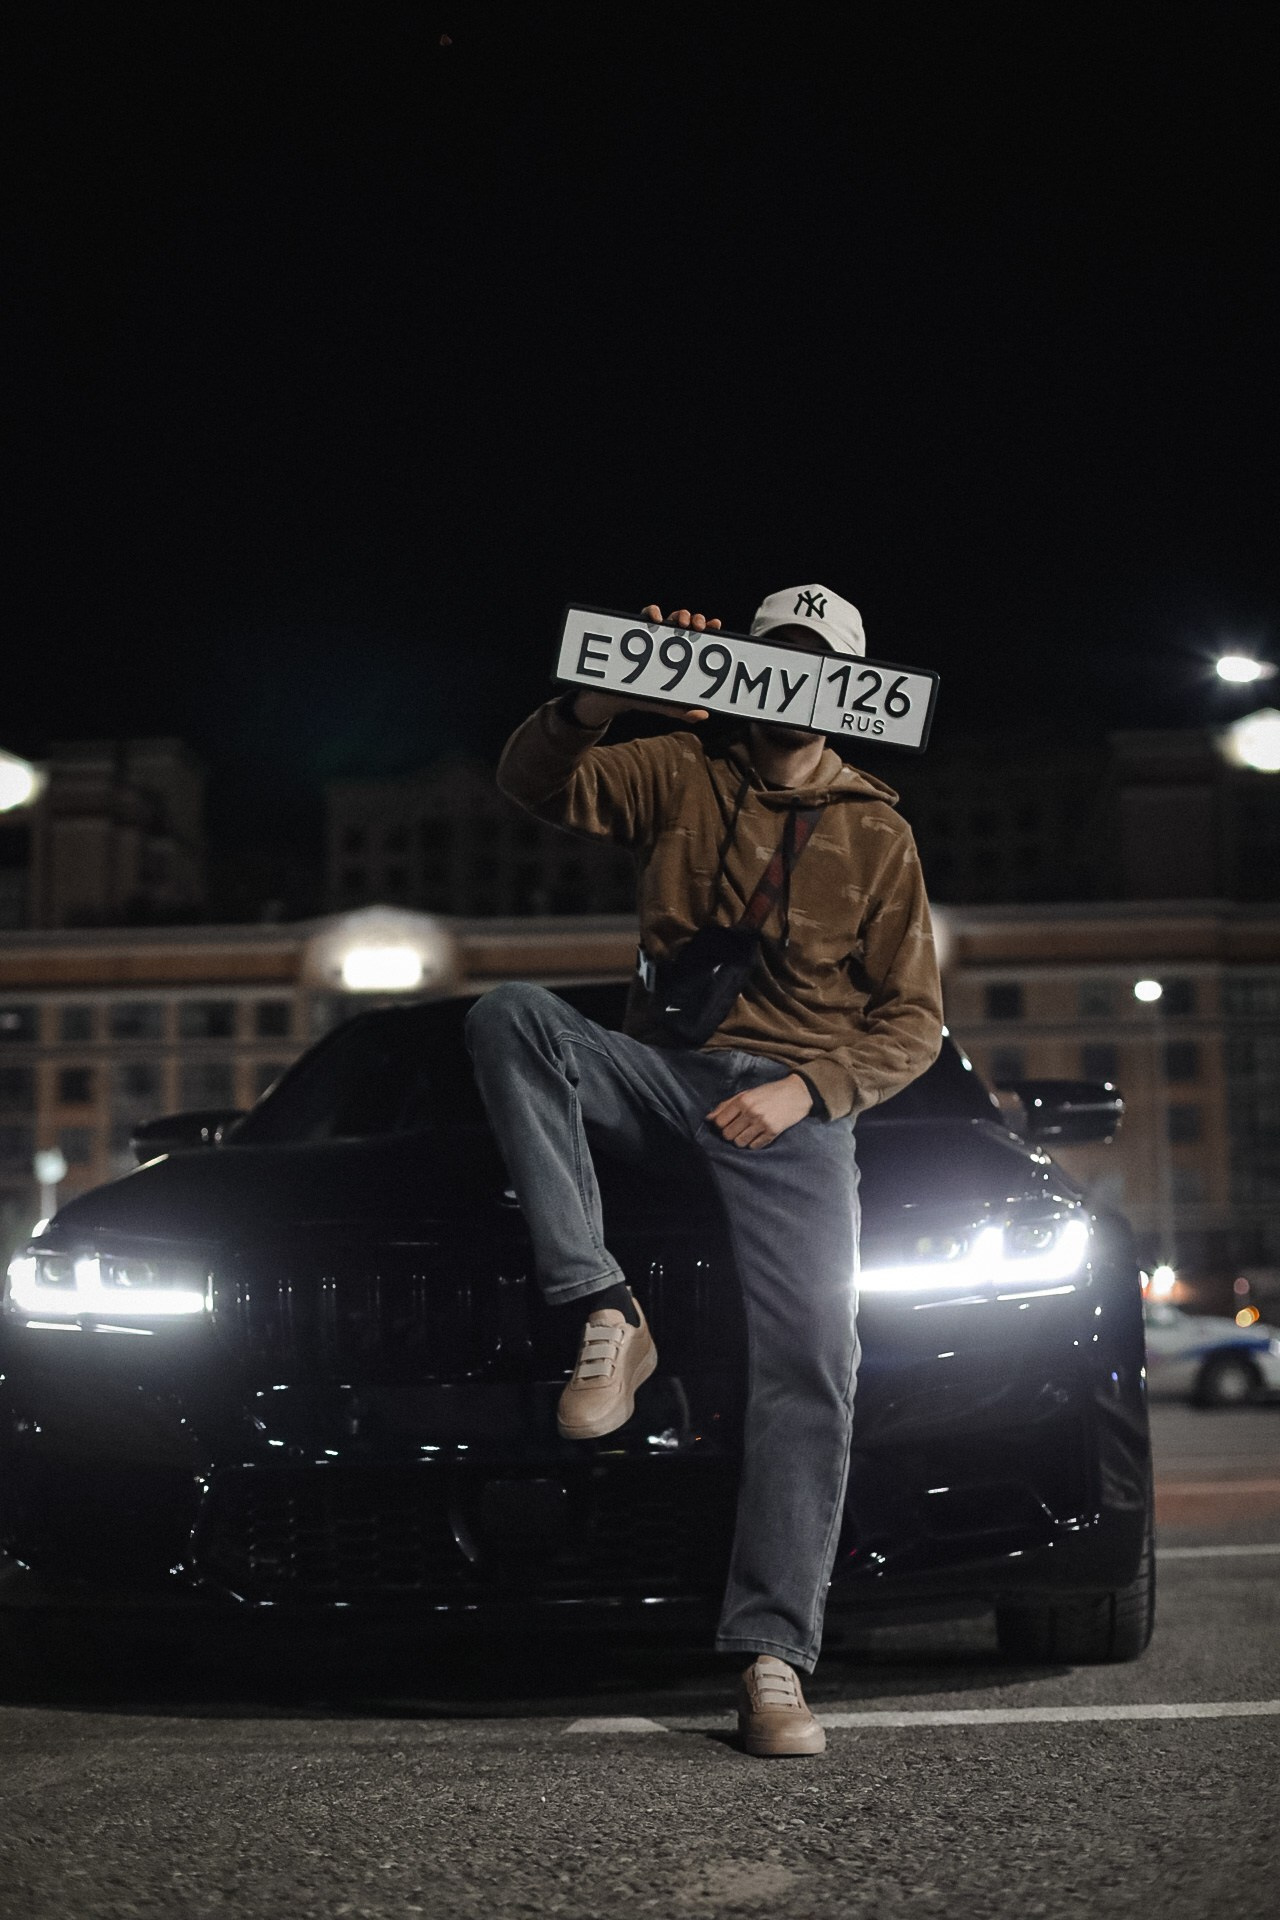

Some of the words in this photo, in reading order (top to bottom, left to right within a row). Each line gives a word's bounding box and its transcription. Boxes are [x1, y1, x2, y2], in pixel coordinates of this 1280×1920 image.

[793, 590, 828, 619] NY
[827, 664, 912, 718] 126
[840, 713, 885, 735] RUS
